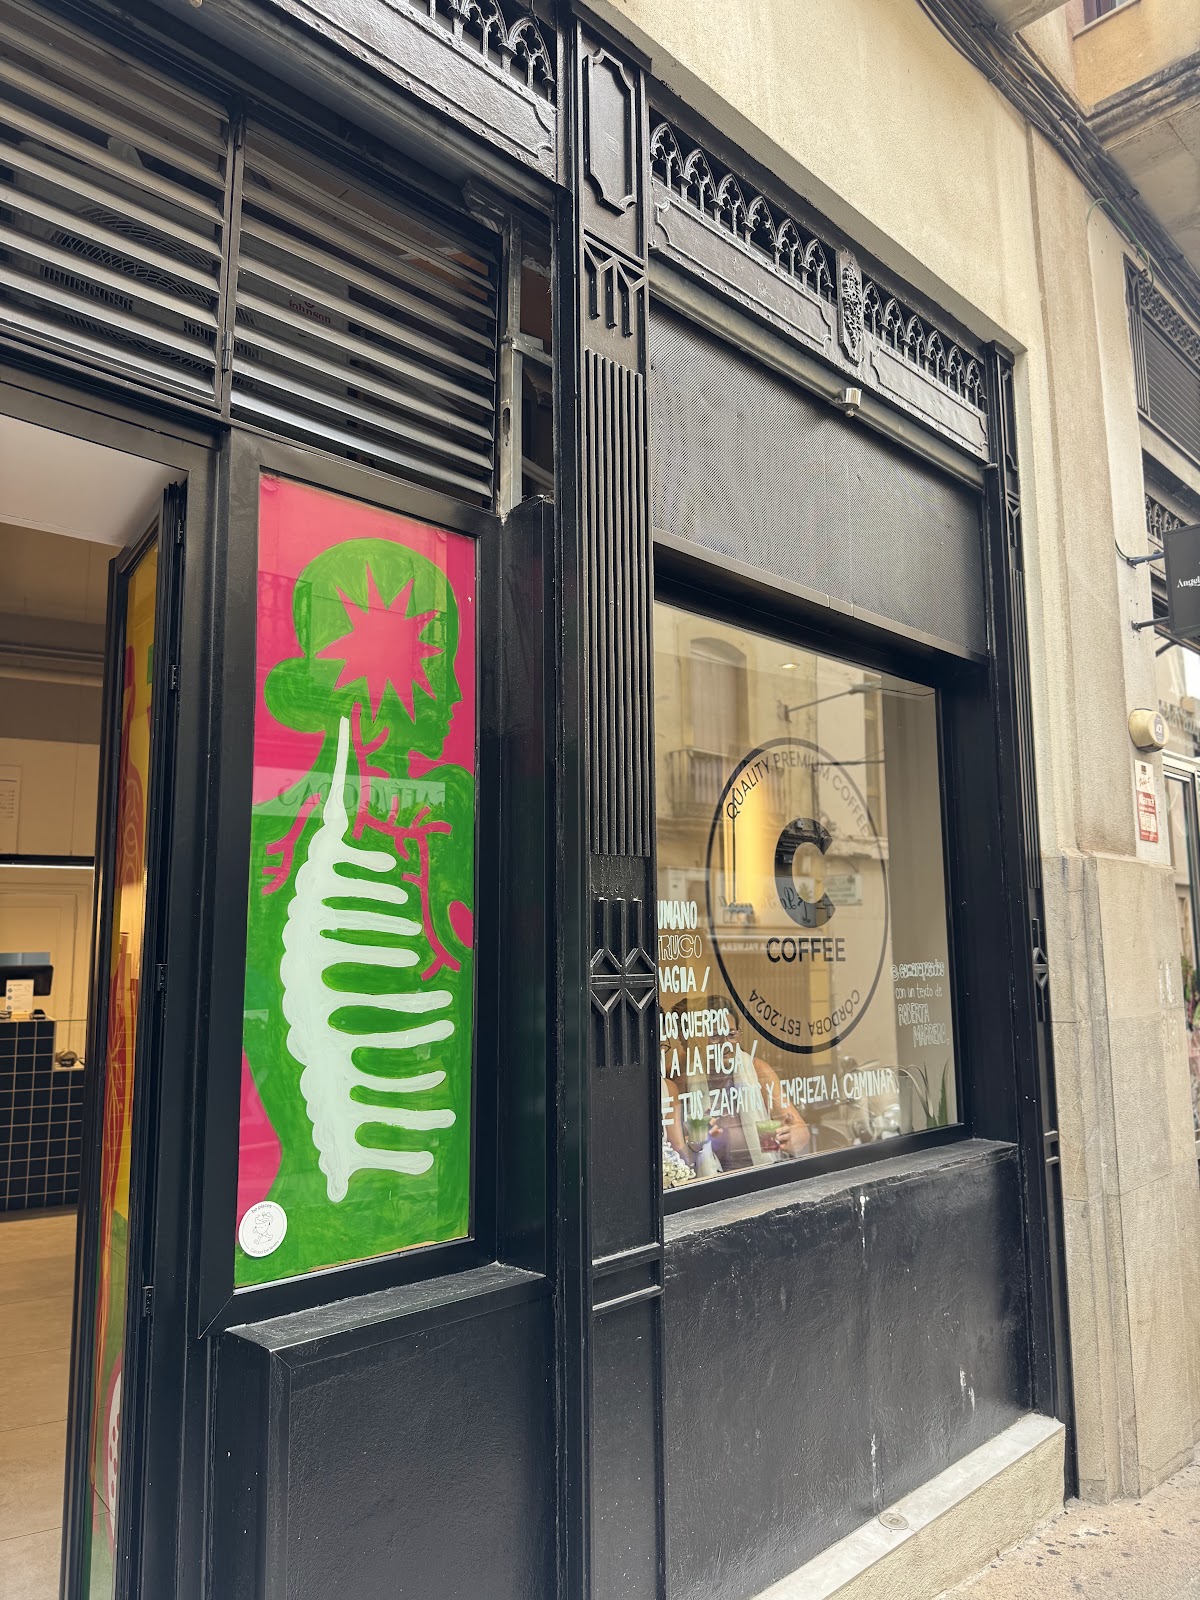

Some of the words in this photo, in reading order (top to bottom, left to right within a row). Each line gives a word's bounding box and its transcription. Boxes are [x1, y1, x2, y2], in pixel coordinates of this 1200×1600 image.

[726, 756, 770, 820] QUALITY
[773, 751, 830, 782] PREMIUM
[832, 774, 870, 838] COFFEE
[774, 817, 836, 928] C
[766, 937, 846, 962] COFFEE
[895, 987, 906, 999] con
[916, 983, 933, 999] texto
[934, 982, 943, 998] de
[659, 1011, 679, 1041] LOS
[680, 1007, 730, 1040] CUERPOS
[808, 989, 861, 1037] CÓRDOBA
[669, 1048, 681, 1079] A
[686, 1045, 704, 1077] LA
[706, 1041, 745, 1075] FUGA
[678, 1089, 704, 1122] TUS
[709, 1084, 763, 1117] ZAPATOS
[765, 1081, 776, 1110] Y
[779, 1075, 829, 1109] EMPIEZA
[830, 1073, 840, 1100] A
